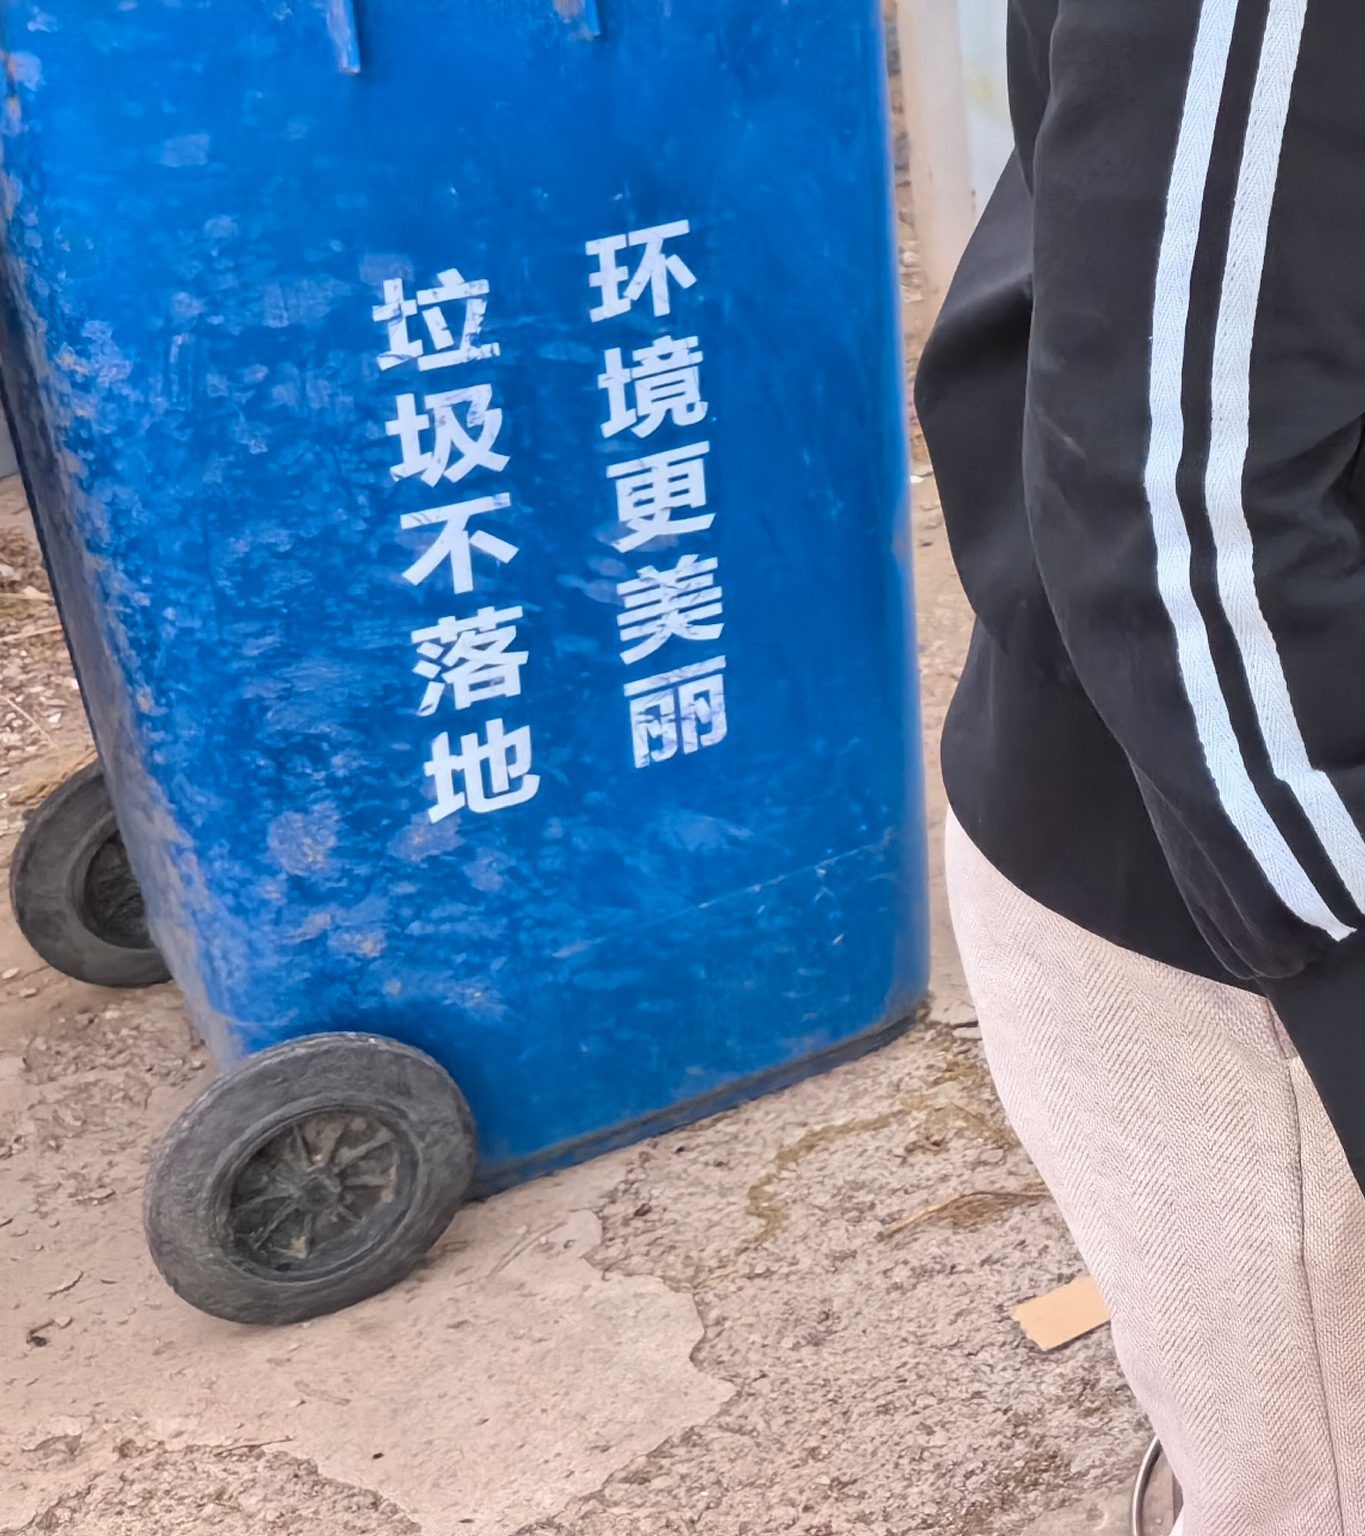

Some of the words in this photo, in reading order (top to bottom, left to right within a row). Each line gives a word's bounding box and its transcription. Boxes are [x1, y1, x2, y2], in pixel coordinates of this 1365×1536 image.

[372, 268, 541, 824] 垃圾不落地
[585, 220, 728, 769] 环境更美丽
